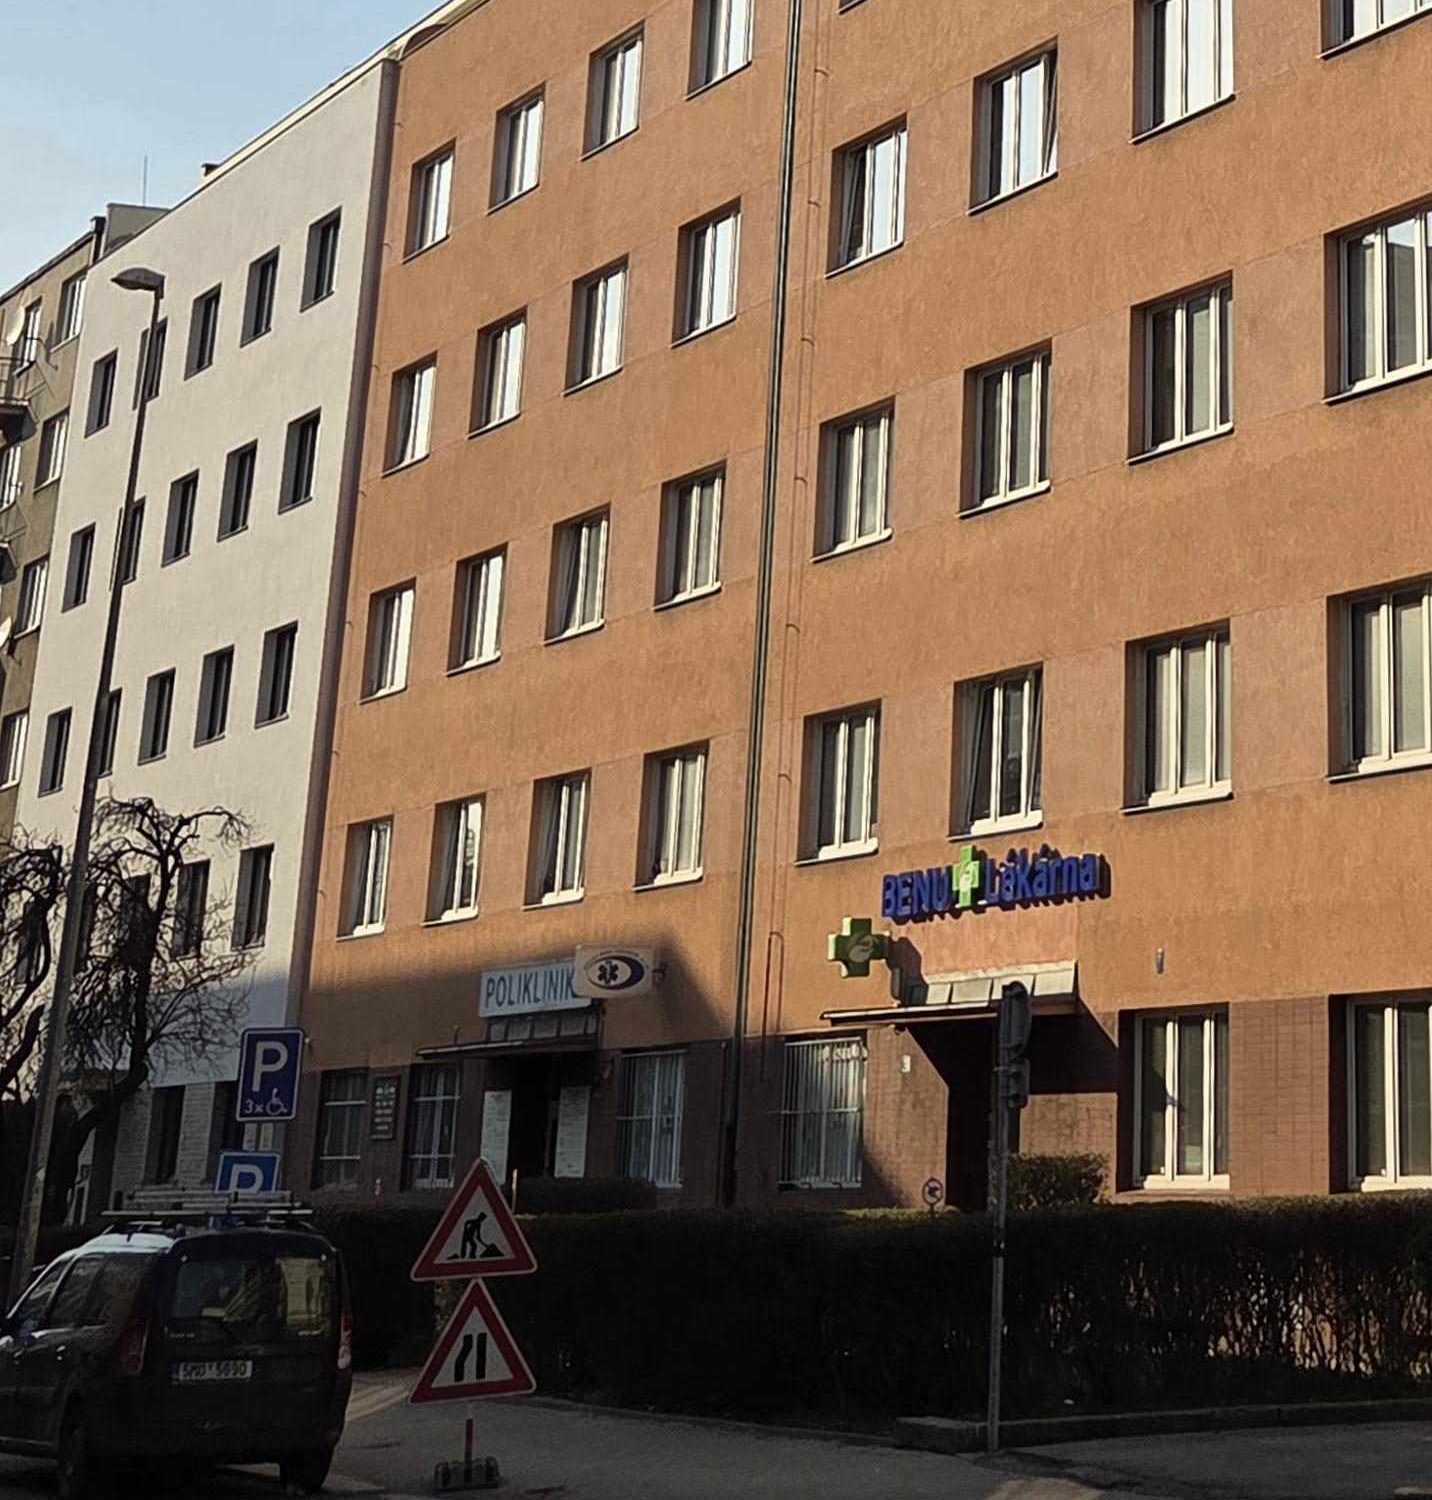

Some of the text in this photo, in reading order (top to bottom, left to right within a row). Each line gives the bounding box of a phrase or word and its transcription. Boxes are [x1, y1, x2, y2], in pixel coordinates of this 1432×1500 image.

[882, 844, 1099, 917] BENU Lékárna
[484, 966, 577, 1008] POLIKLINIK
[251, 1040, 289, 1093] P
[244, 1099, 264, 1114] 3x
[228, 1163, 264, 1193] P
